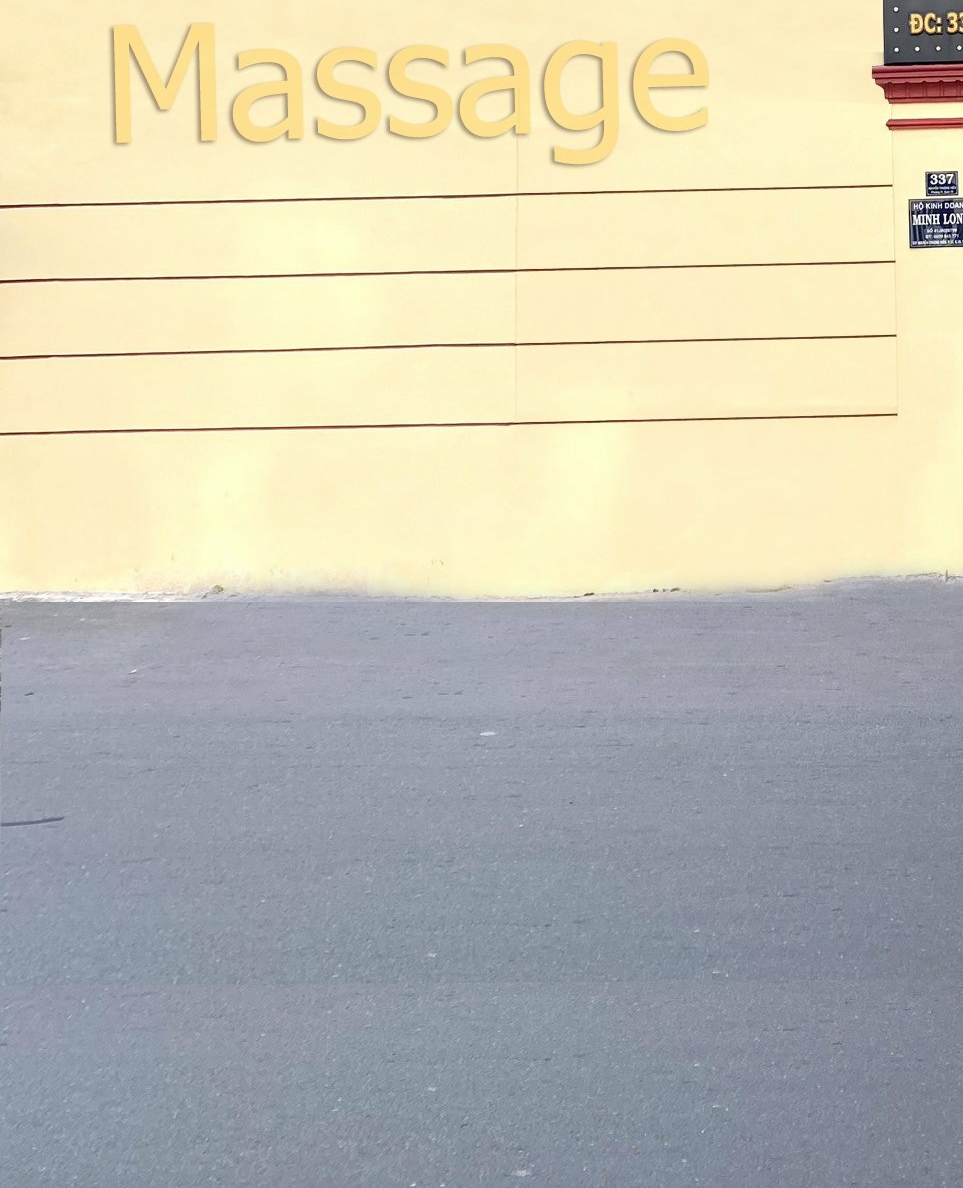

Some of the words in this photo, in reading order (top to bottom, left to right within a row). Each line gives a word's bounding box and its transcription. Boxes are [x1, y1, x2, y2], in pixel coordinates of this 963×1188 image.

[909, 13, 942, 34] ĐC:
[110, 22, 711, 166] Massage
[929, 173, 954, 186] 337
[925, 202, 943, 210] KINH
[912, 214, 941, 226] MINH
